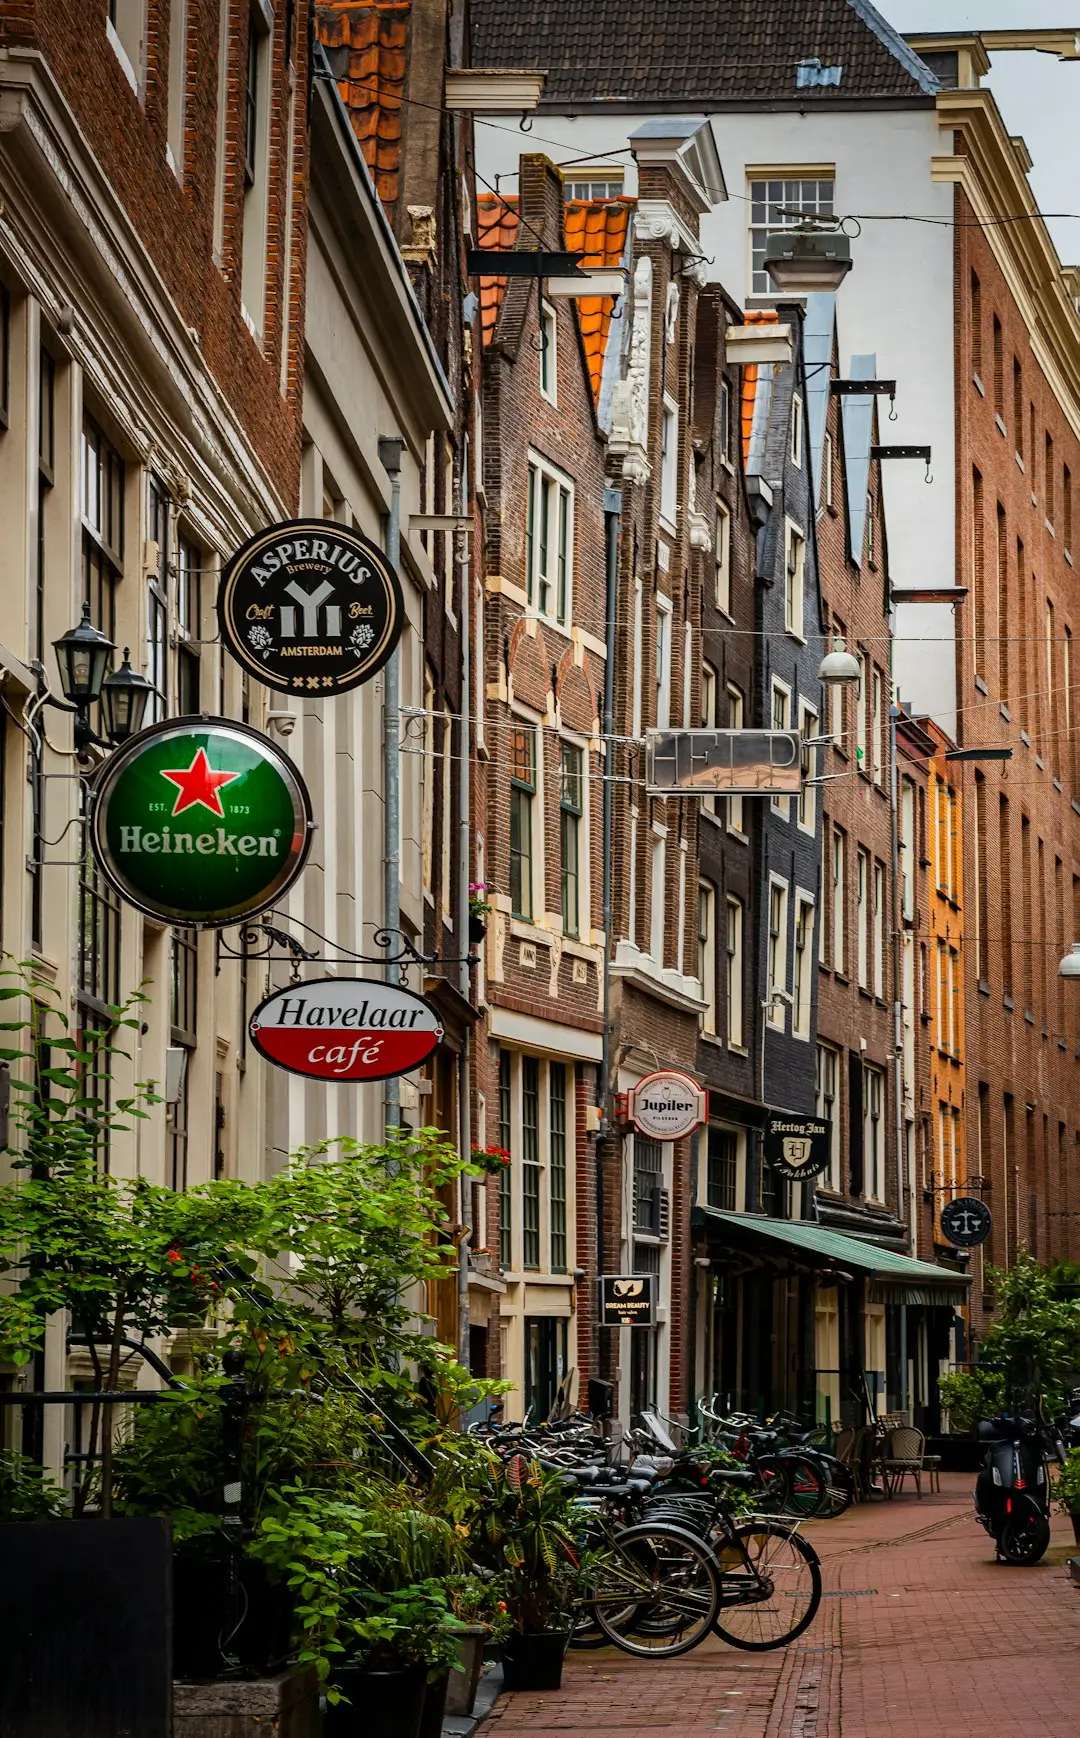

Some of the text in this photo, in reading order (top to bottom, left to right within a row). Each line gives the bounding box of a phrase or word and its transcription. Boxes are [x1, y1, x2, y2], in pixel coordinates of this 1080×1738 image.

[250, 539, 372, 588] ASPERIUS
[285, 562, 332, 575] Brewery
[245, 603, 275, 620] Craft
[348, 601, 375, 619] Beer
[280, 645, 343, 657] AMSTERDAM
[149, 803, 250, 815] EST. 1873
[275, 998, 424, 1028] Havelaar
[307, 1036, 385, 1073] café
[640, 1099, 693, 1113] Jupiler
[770, 1120, 826, 1136] Hertog Jan
